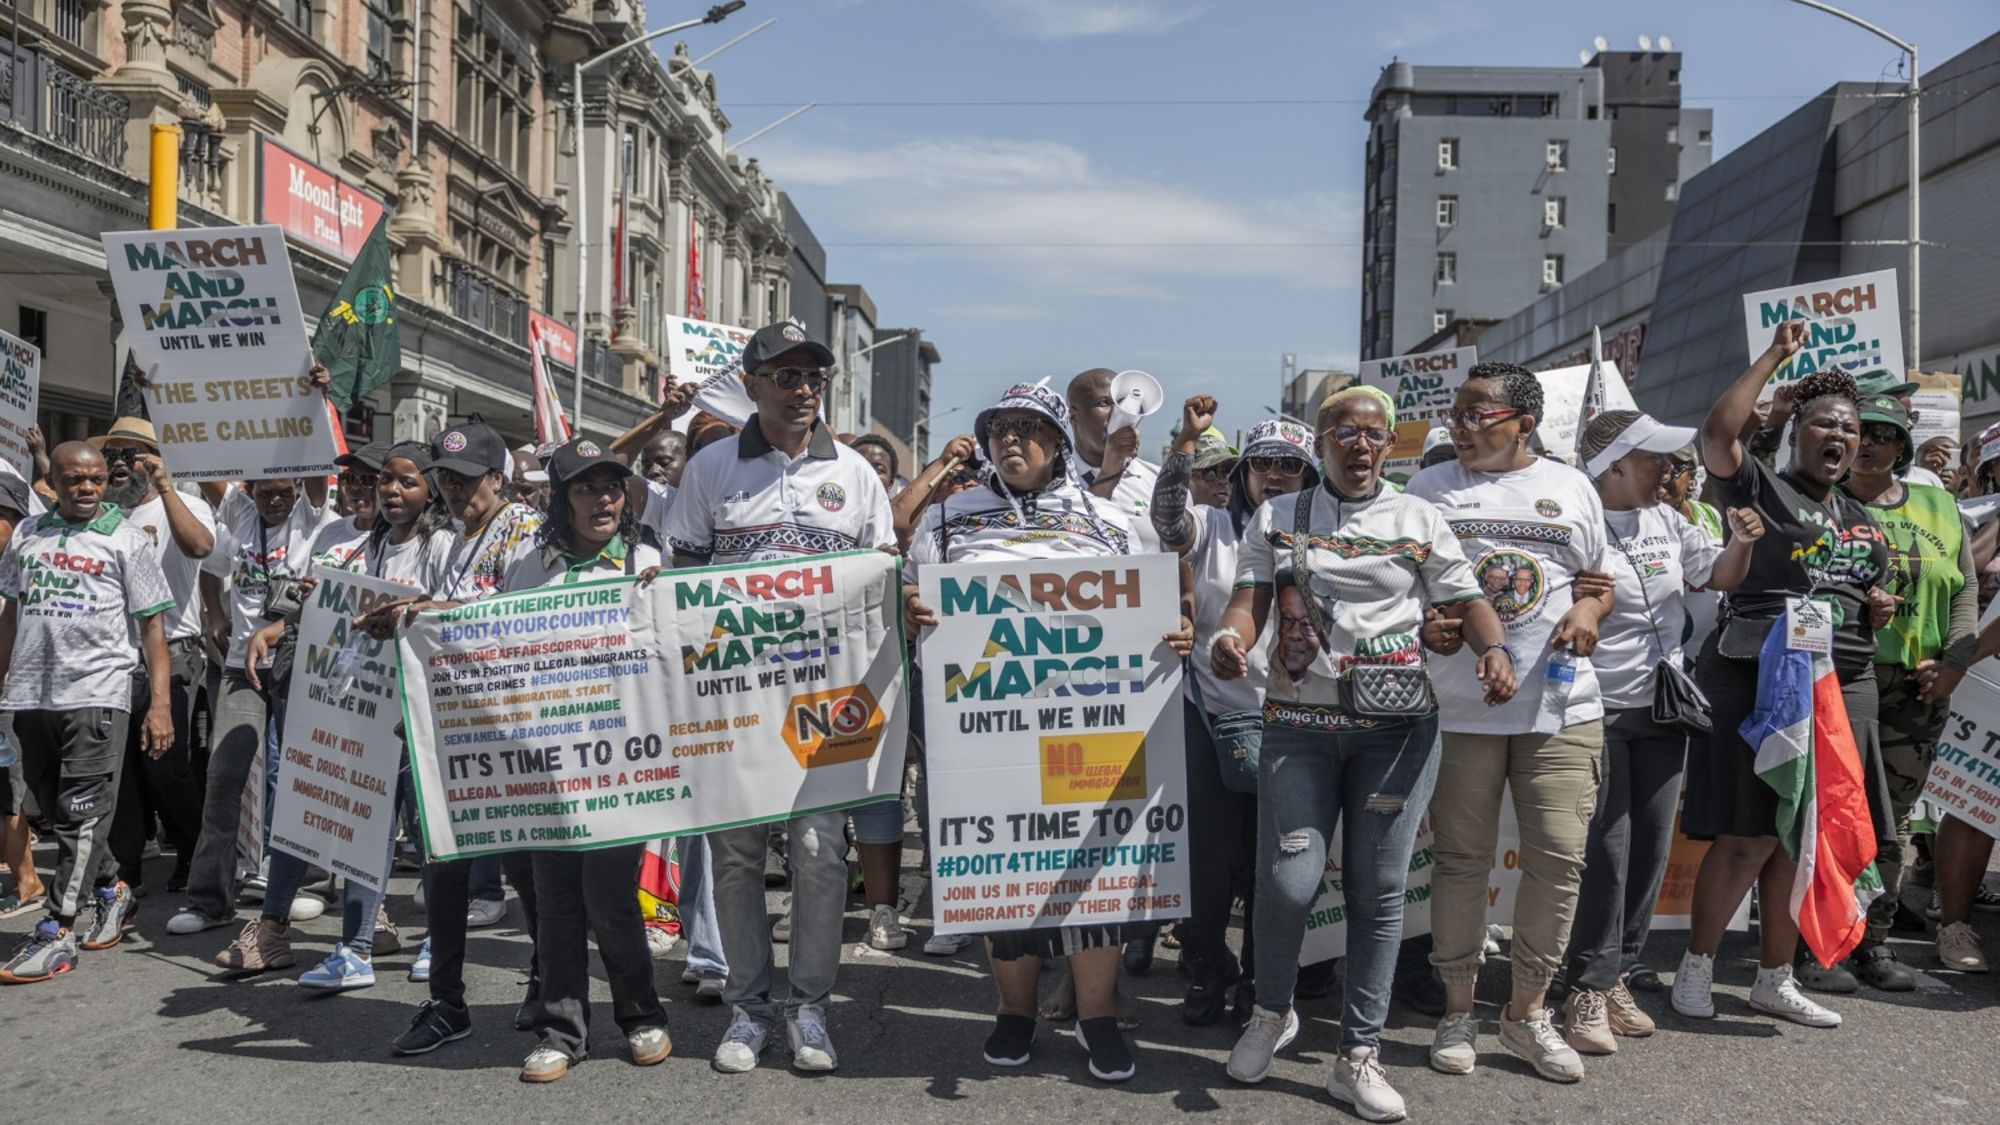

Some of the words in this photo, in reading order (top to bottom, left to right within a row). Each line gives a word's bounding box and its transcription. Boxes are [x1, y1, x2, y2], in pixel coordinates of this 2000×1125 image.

[124, 237, 266, 271] MARCH
[164, 269, 244, 299] AND
[140, 298, 281, 330] MARCH
[1760, 283, 1876, 328] MARCH
[160, 334, 204, 350] UNTIL
[208, 334, 232, 348] WE
[236, 332, 265, 347] WIN
[705, 340, 744, 355] AN
[1803, 317, 1856, 349] ND
[4, 358, 26, 380] AND
[696, 366, 717, 374] UNT
[1381, 353, 1458, 378] MARCH
[150, 382, 197, 405] THE
[205, 376, 312, 402] STREETS
[1399, 374, 1443, 392] AND
[162, 422, 208, 444] ARE
[217, 417, 313, 441] CALLING
[1396, 412, 1416, 422] NTIL
[1420, 410, 1433, 419] WE
[171, 469, 244, 478] #DOIT4YOURCOUNTRY
[263, 464, 334, 474] #DOIT4THEIRFUTURE
[1900, 522, 1948, 558] WESIZWE
[20, 552, 105, 576] MARCH
[29, 571, 80, 589] AND
[675, 565, 834, 611] MARCH
[940, 569, 1141, 617] MARCH
[317, 579, 401, 616] MARC
[437, 588, 622, 623] #DOIT4THEIRFUTURE
[439, 608, 631, 643] #DOIT4YOURCOUNTRY
[711, 602, 805, 640] AND
[982, 614, 1104, 658] AND
[428, 635, 626, 667] #STOPHOMEAFFAIRSCORRUPTION
[432, 671, 451, 682] JOIN
[454, 670, 468, 681] US
[470, 668, 481, 679] IN
[483, 663, 530, 678] FIGHTING
[534, 658, 578, 673] ILLEGAL
[580, 650, 647, 667] IMMIGRANTS
[681, 627, 840, 675] MARCH
[434, 686, 452, 697] AND
[455, 682, 484, 695] THEIR
[487, 679, 526, 691] CRIMES
[530, 663, 649, 686] #ENOUGHISENOUGH
[696, 676, 752, 697] UNTIL
[758, 670, 786, 688] WE
[794, 664, 826, 683] WIN
[944, 654, 1144, 702] MARCH
[339, 697, 354, 711] WE
[357, 698, 377, 719] WIN
[436, 701, 459, 711] STOP
[461, 698, 500, 709] ILLEGAL
[576, 684, 612, 696] START
[439, 719, 468, 729] LEGAL
[470, 711, 532, 727] IMMIGRATION
[539, 699, 621, 718] #ABAHAMBE
[669, 719, 728, 737] RECLAIM
[733, 714, 759, 728] OUR
[959, 709, 1029, 734] UNTIL
[1038, 707, 1073, 730] WE
[1083, 704, 1125, 727] WIN
[1275, 710, 1311, 723] LONG
[1316, 714, 1350, 725] LIVE
[311, 728, 339, 748] AWAY
[341, 738, 363, 758] WITH
[444, 730, 506, 745] SEKWANELE
[511, 721, 583, 740] ABAGODUKE
[588, 716, 627, 731] ABONI
[828, 737, 872, 749] IMMIGRATION
[449, 756, 493, 780] IT'S
[500, 746, 562, 775] TIME
[573, 740, 613, 767] TO
[624, 734, 662, 761] GO
[672, 740, 734, 758] COUNTRY
[1046, 742, 1083, 777] NO
[285, 747, 314, 771] CRIME,
[316, 759, 347, 783] DRUGS,
[350, 768, 387, 796] ILLEGAL
[448, 782, 501, 802] ILLEGAL
[506, 777, 591, 797] IMMIGRATION
[598, 775, 611, 788] IS
[617, 772, 628, 785] A
[634, 765, 680, 783] CRIME
[1069, 775, 1141, 790] IMMIGRATION
[1085, 764, 1122, 777] ILLEGAL
[293, 778, 350, 811] IMMIGRATION
[352, 802, 371, 820] AND
[1932, 765, 1950, 781] US
[1952, 775, 1964, 789] IN
[1967, 783, 2000, 808] FIGHT
[451, 809, 480, 823] LAW
[486, 800, 579, 820] ENFORCEMENT
[585, 791, 619, 811] WHO
[624, 786, 675, 807] TAKES
[681, 785, 692, 799] A
[1969, 806, 1997, 825] AND
[303, 810, 354, 843] EXTORTION
[456, 827, 496, 847] BRIBE
[500, 829, 512, 842] IS
[517, 828, 527, 841] A
[531, 824, 591, 840] CRIMINAL
[940, 816, 994, 846] IT'S
[1007, 811, 1080, 842] TIME
[1093, 807, 1133, 837] TO
[1145, 803, 1184, 833] GO
[937, 842, 1176, 878] #DOIT4THEIRFUTURE
[942, 885, 976, 902] JOIN
[982, 883, 1000, 898] US
[1006, 882, 1021, 897] IN
[1026, 879, 1092, 897] FIGHTING
[1098, 875, 1157, 891] ILLEGAL
[943, 905, 1035, 923] IMMIGRANTS
[1042, 901, 1072, 917] AND
[1078, 898, 1121, 914] THEIR
[1127, 894, 1181, 911] CRIMES
